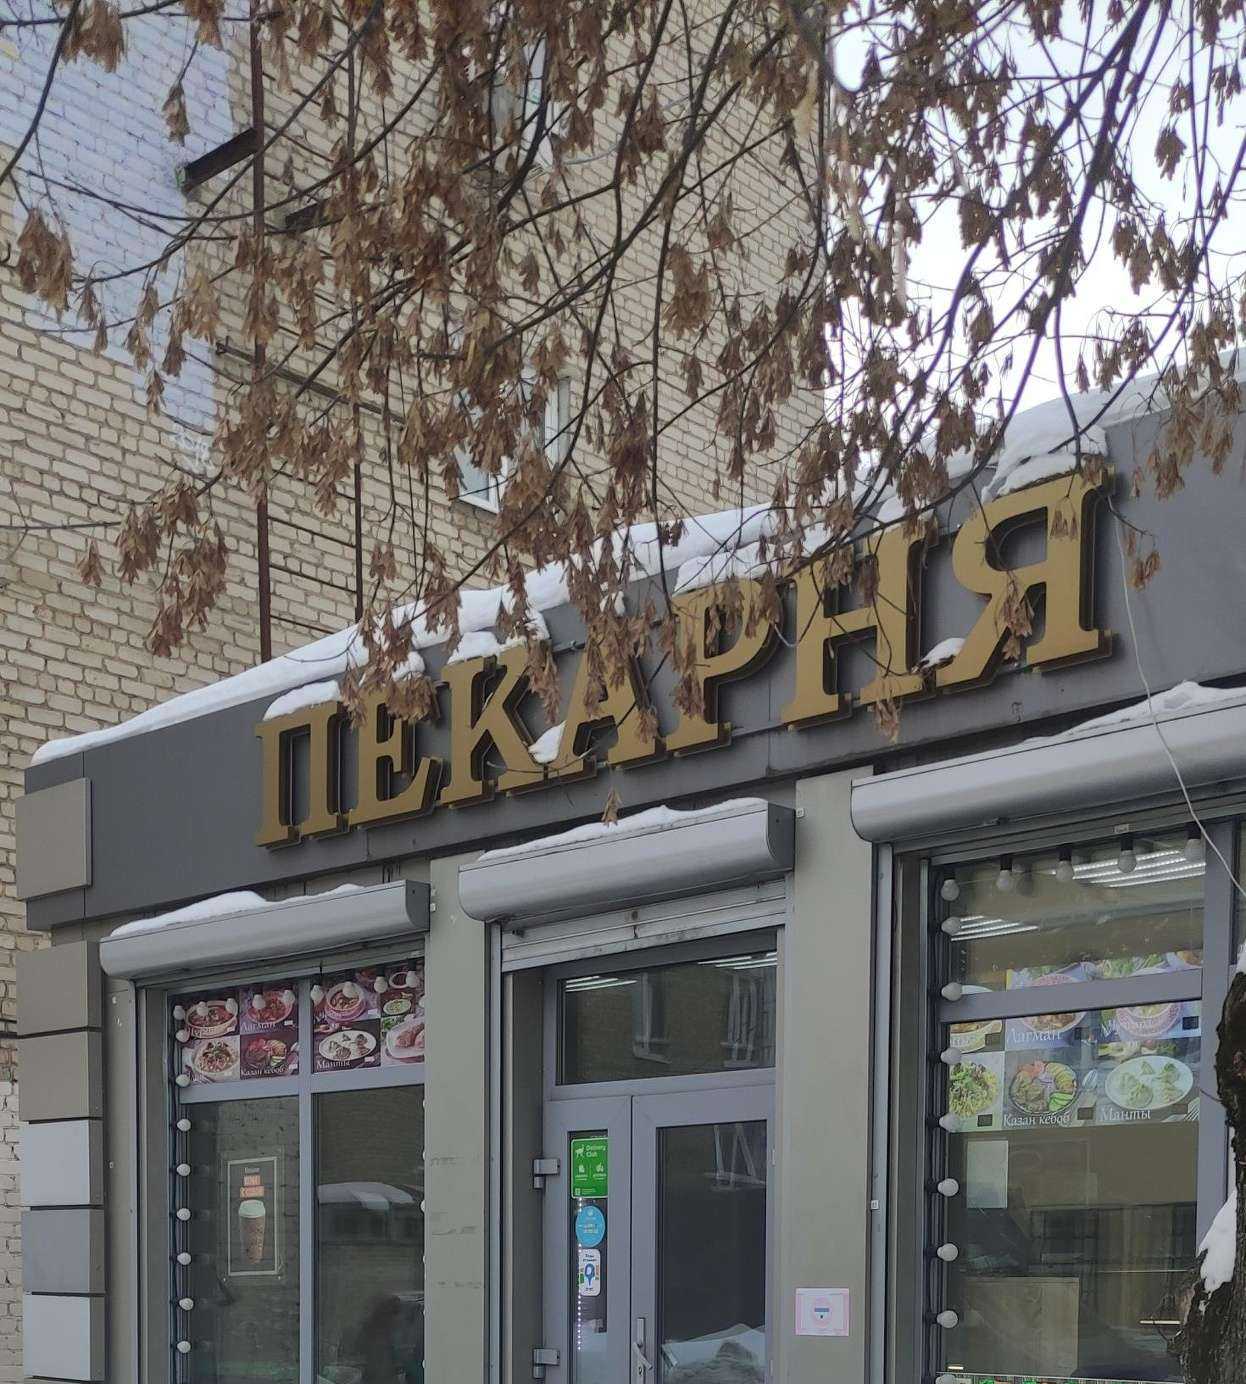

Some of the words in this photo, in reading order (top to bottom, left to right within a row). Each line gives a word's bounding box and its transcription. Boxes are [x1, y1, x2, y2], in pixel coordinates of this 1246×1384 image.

[254, 468, 1115, 849] ПЕКАРНЯ
[1006, 1027, 1061, 1045] Лагман
[1003, 1113, 1036, 1127] Казан
[1100, 1107, 1151, 1122] Манты
